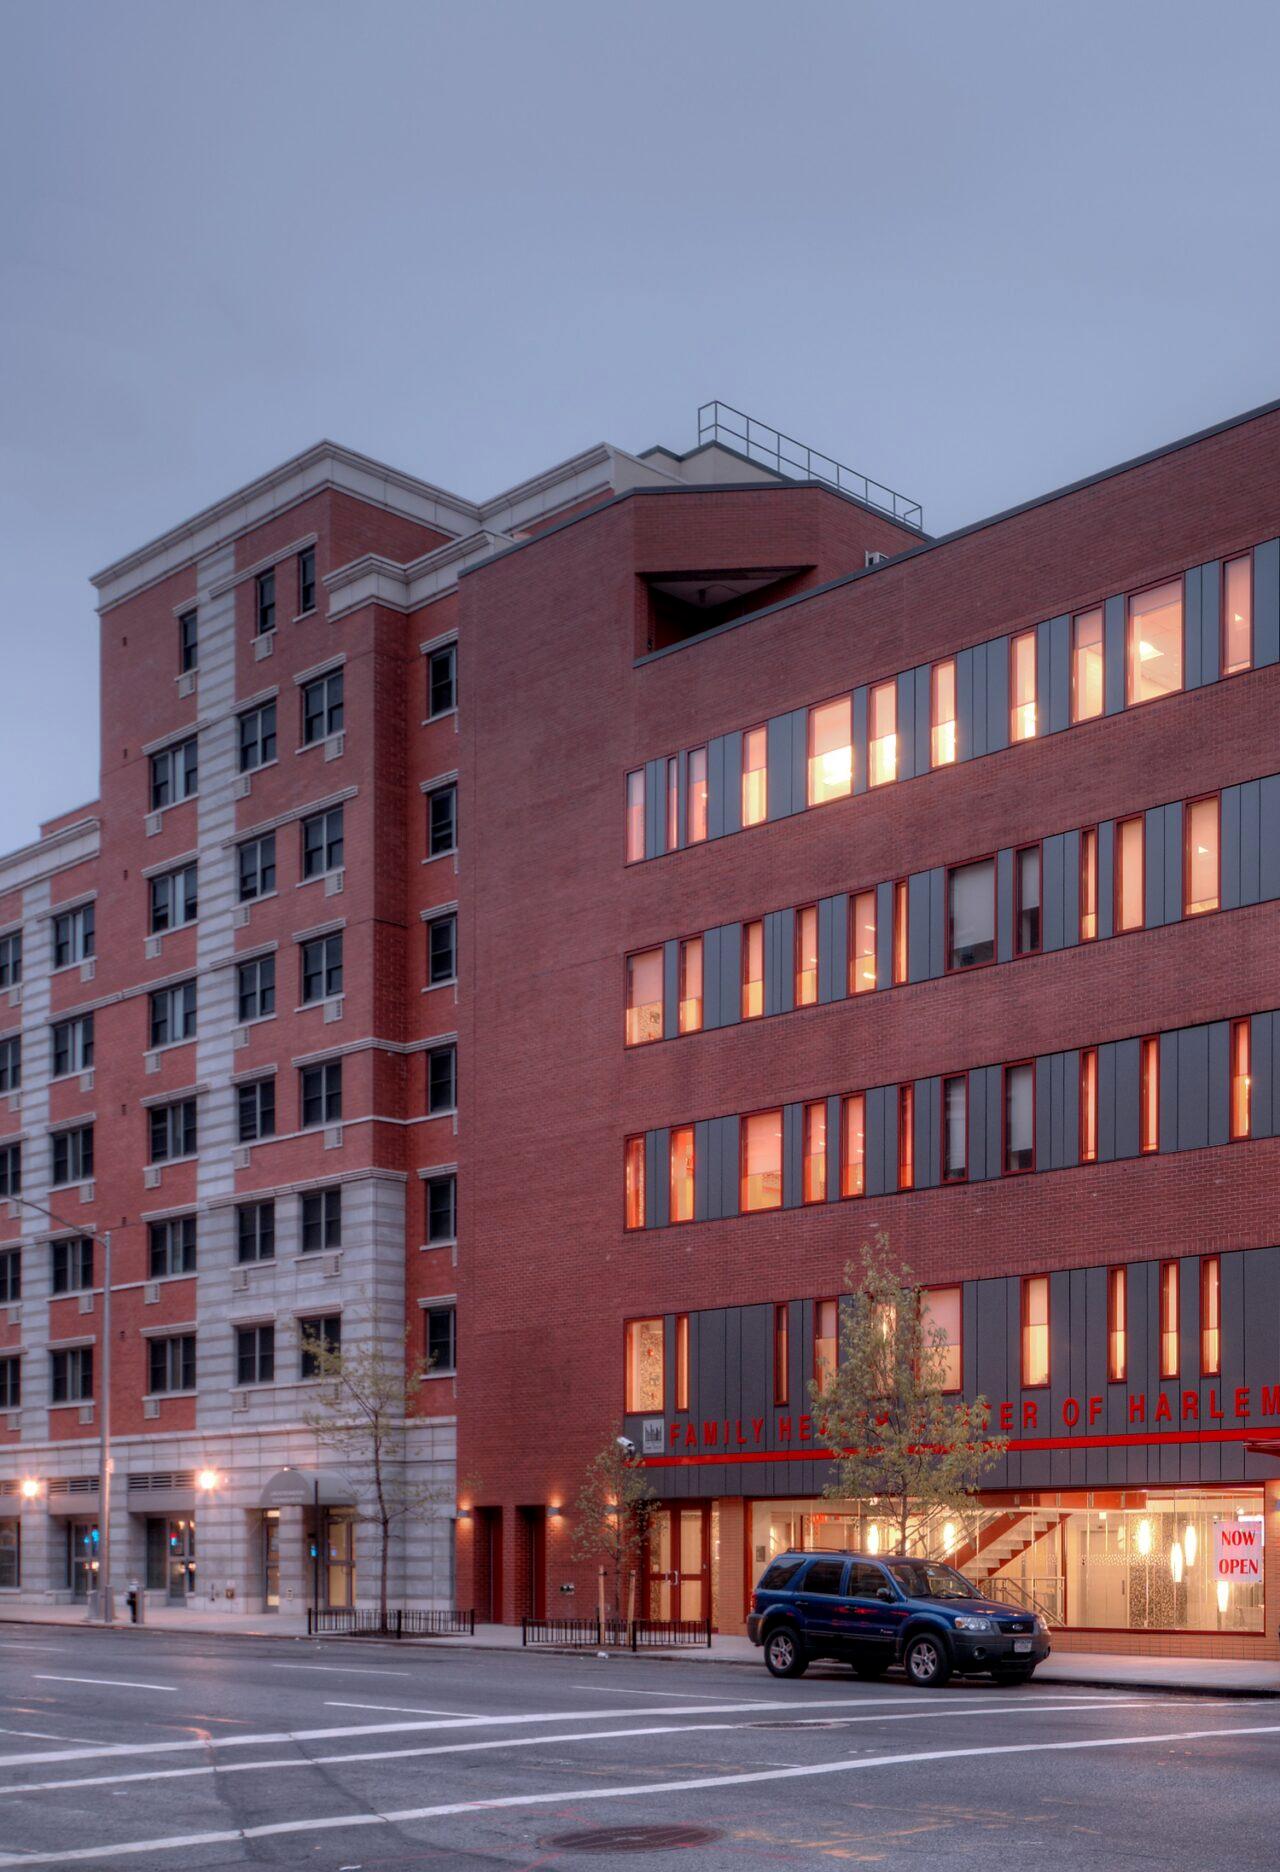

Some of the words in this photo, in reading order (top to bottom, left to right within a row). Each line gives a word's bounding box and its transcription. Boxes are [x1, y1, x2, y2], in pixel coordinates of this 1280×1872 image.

[668, 1416, 764, 1447] FAMILY
[1062, 1396, 1104, 1428] OF
[1221, 1530, 1256, 1546] NOW
[1218, 1558, 1259, 1575] OPEN
